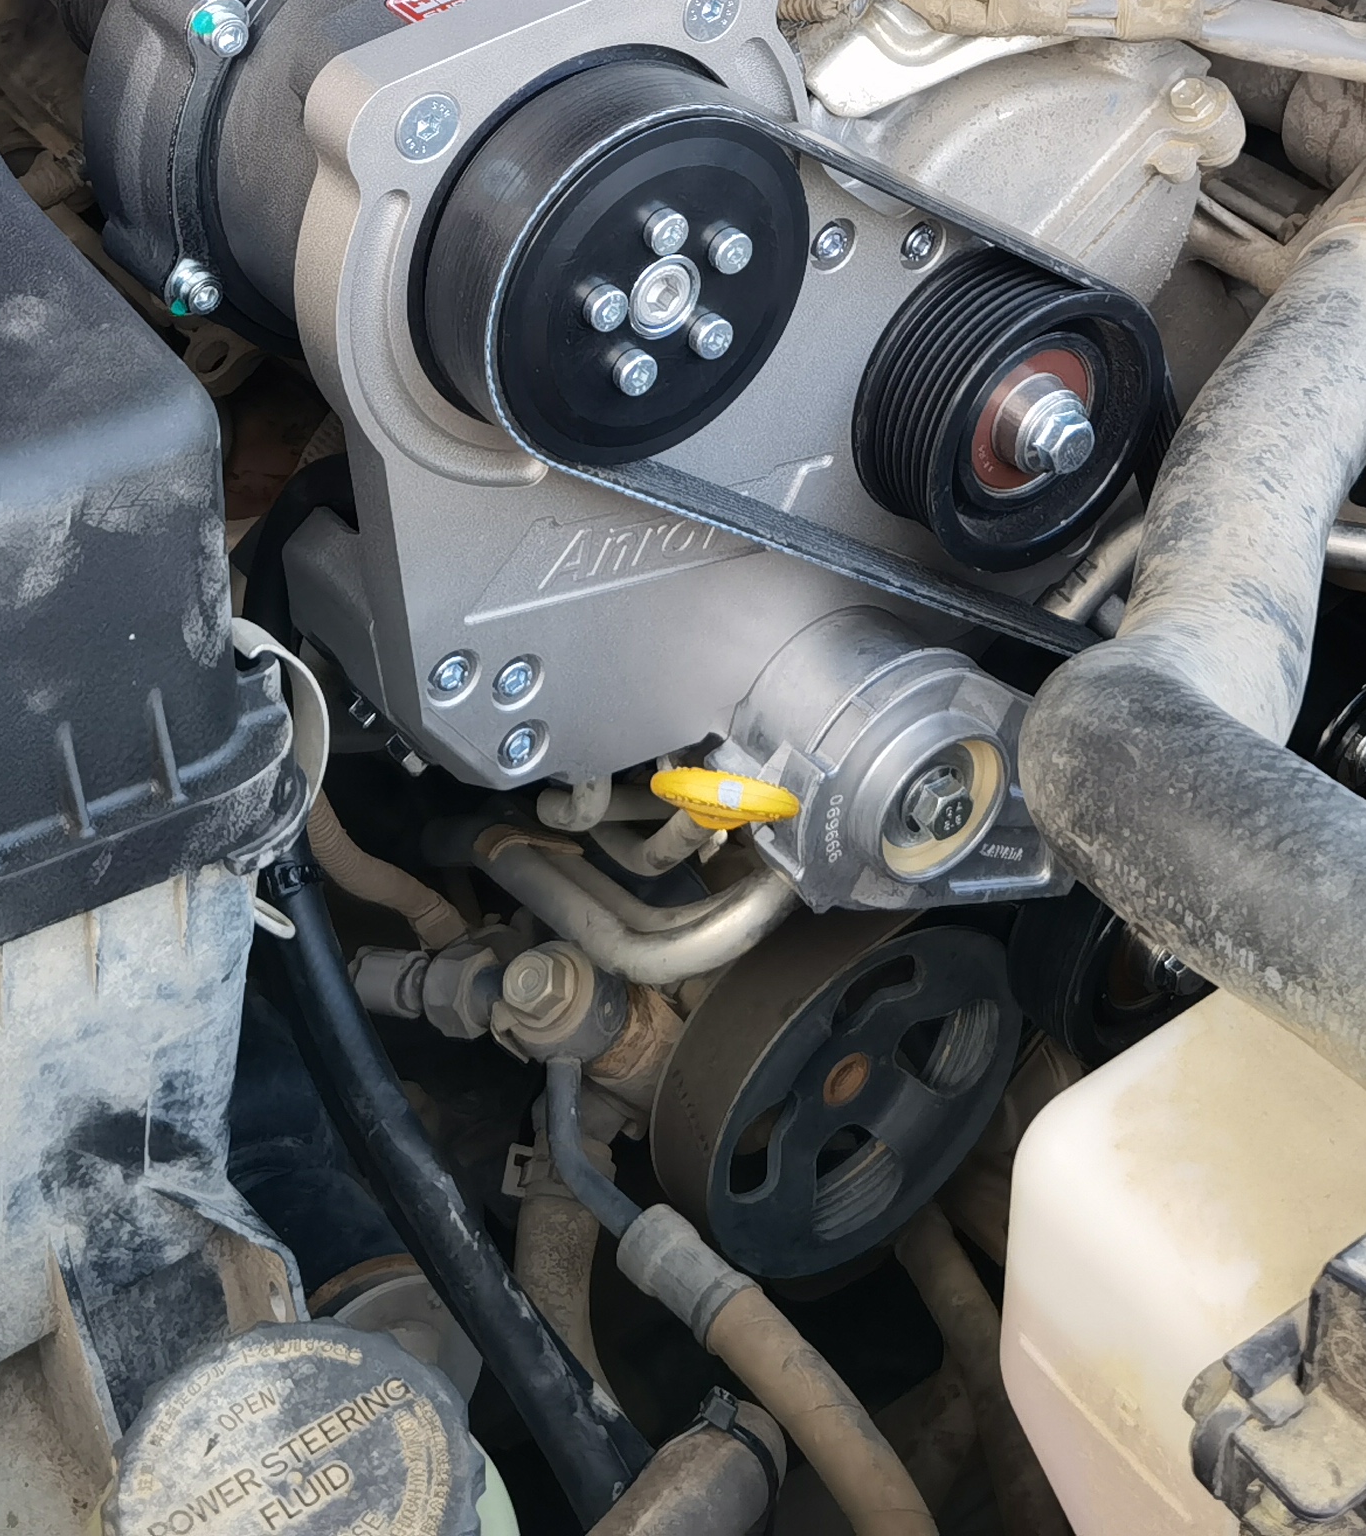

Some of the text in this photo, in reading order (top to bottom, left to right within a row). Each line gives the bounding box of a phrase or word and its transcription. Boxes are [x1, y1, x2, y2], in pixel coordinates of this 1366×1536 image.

[216, 1386, 278, 1433] OPEN
[146, 1466, 263, 1536] POWER
[259, 1376, 411, 1478] STEERING
[259, 1462, 351, 1531] FLUID
